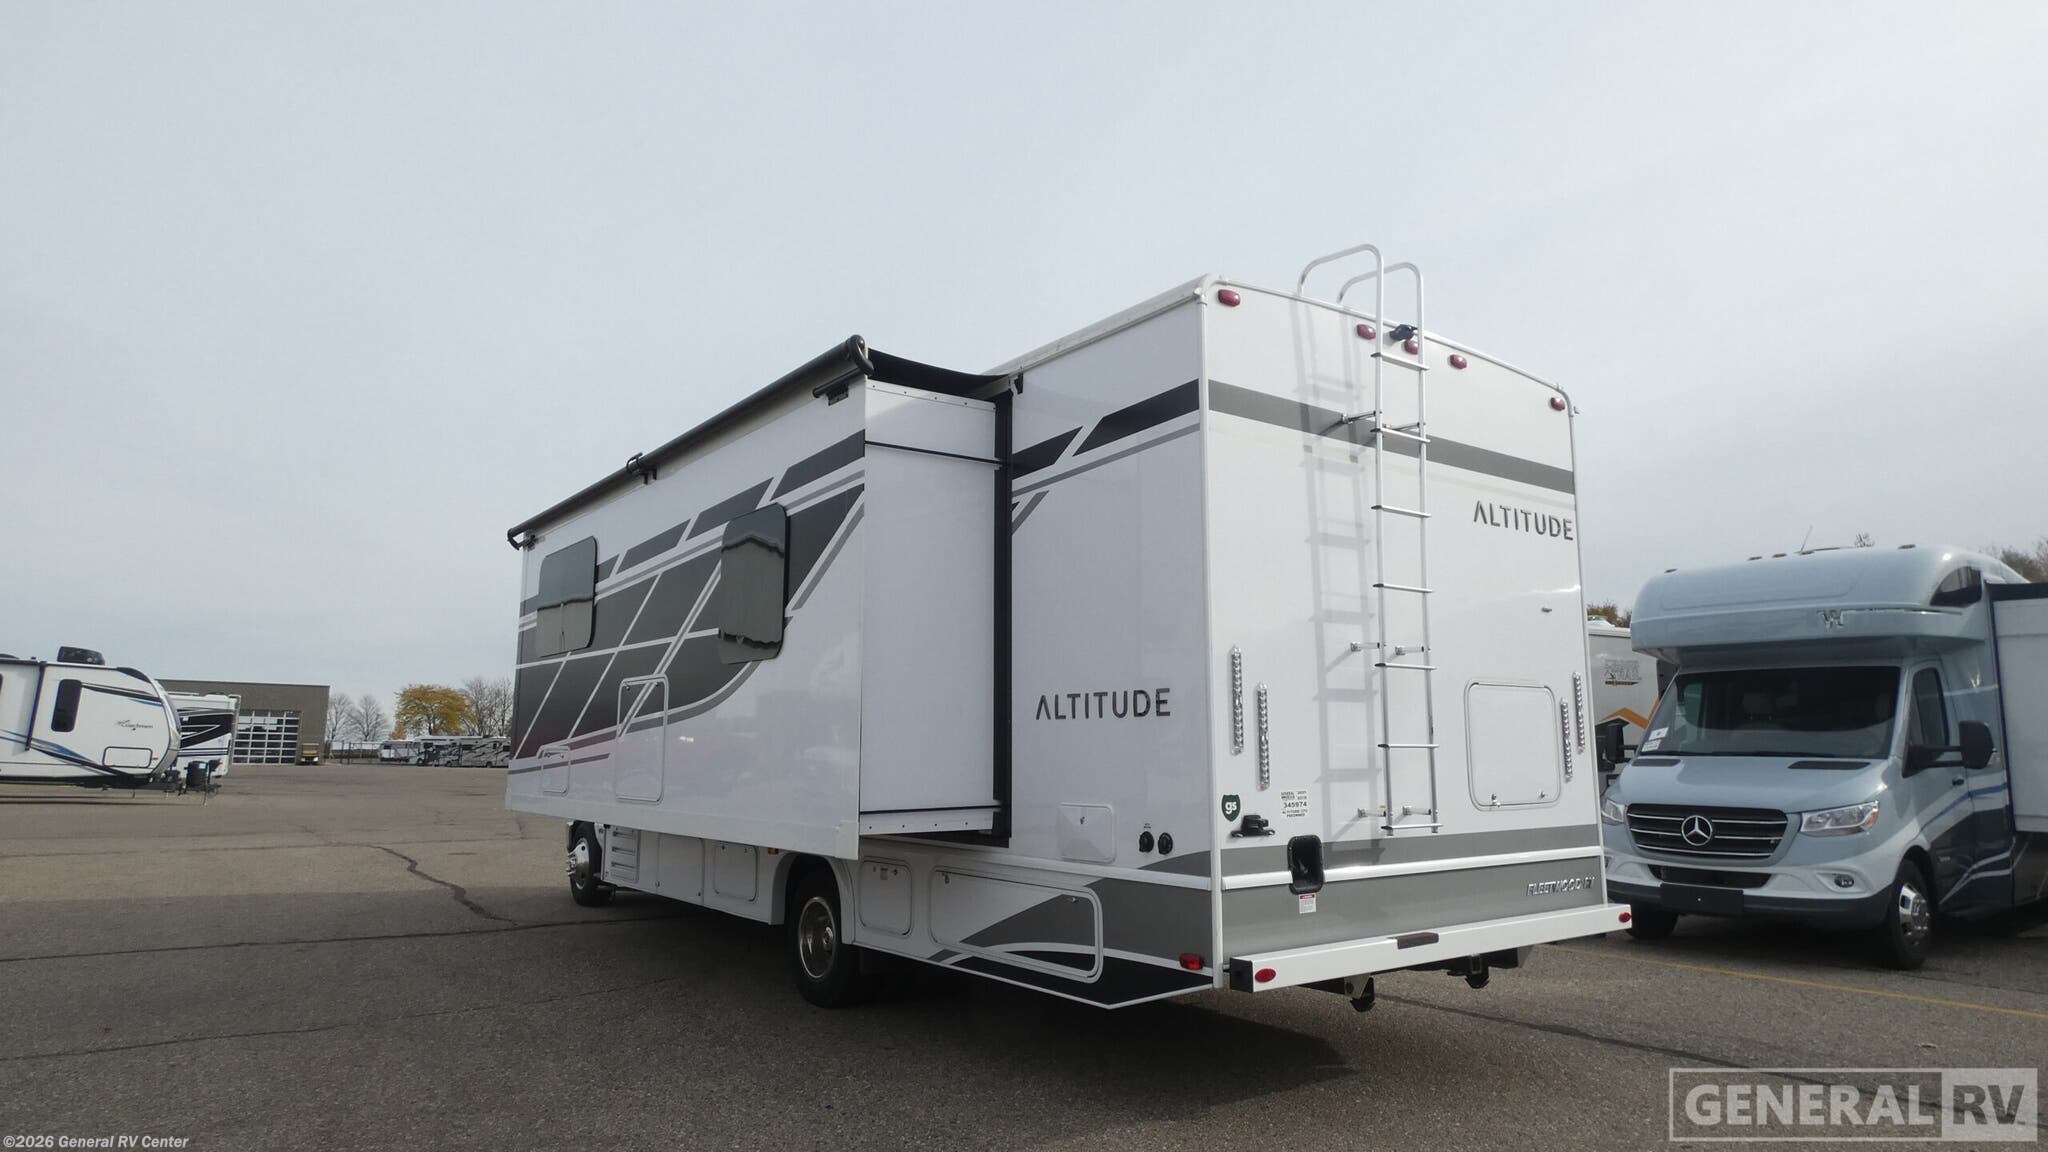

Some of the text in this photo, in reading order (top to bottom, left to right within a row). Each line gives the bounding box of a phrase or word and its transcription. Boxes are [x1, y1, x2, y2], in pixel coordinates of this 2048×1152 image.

[1473, 500, 1574, 541] ALTITUDE
[1035, 687, 1171, 721] ALTITUDE
[1224, 801, 1238, 815] gs
[1283, 801, 1308, 809] 345974
[1526, 878, 1582, 896] FLEETWOOD
